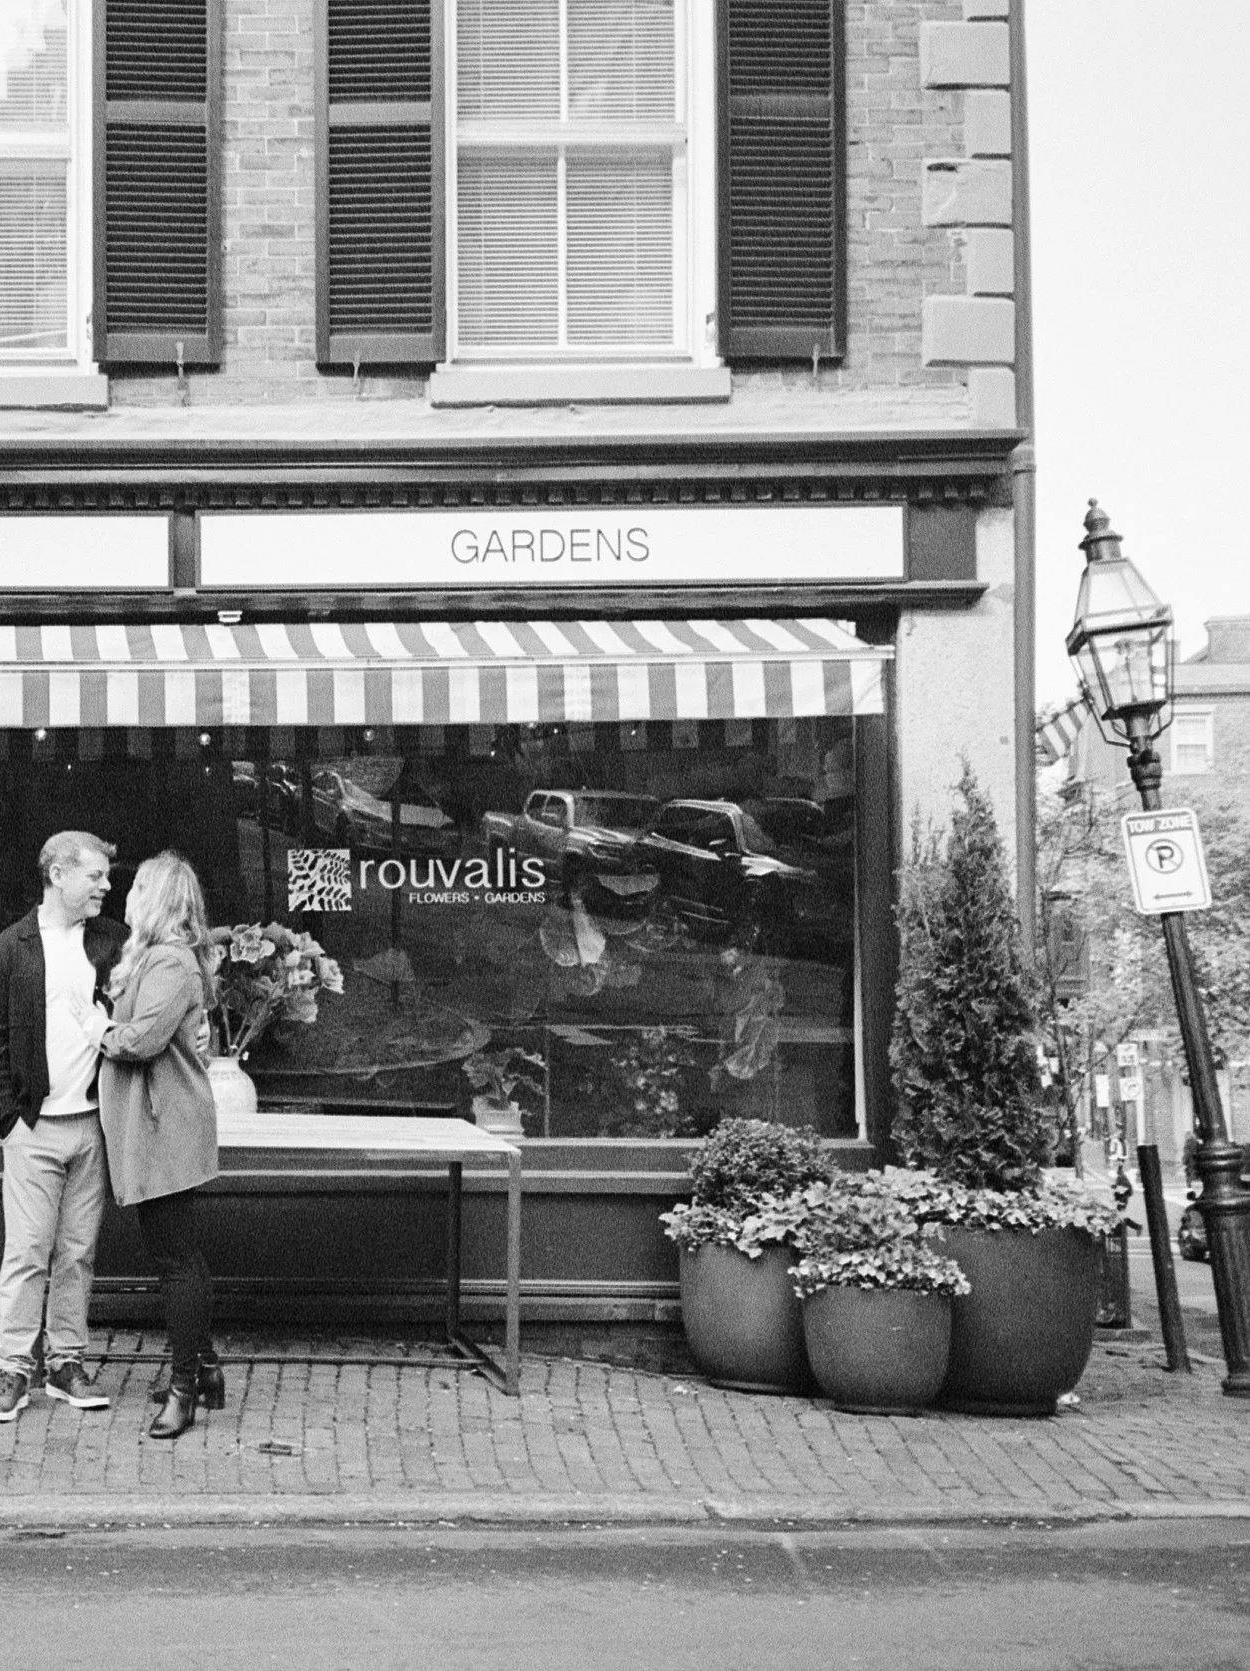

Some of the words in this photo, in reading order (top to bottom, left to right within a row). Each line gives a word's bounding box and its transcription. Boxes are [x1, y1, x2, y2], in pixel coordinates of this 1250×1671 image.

[451, 527, 650, 564] GARDENS
[1127, 818, 1156, 833] TOW
[1158, 815, 1193, 830] ZONE
[359, 847, 546, 890] rouvalis
[409, 892, 470, 904] FLOWERS
[484, 891, 546, 904] GARDENS
